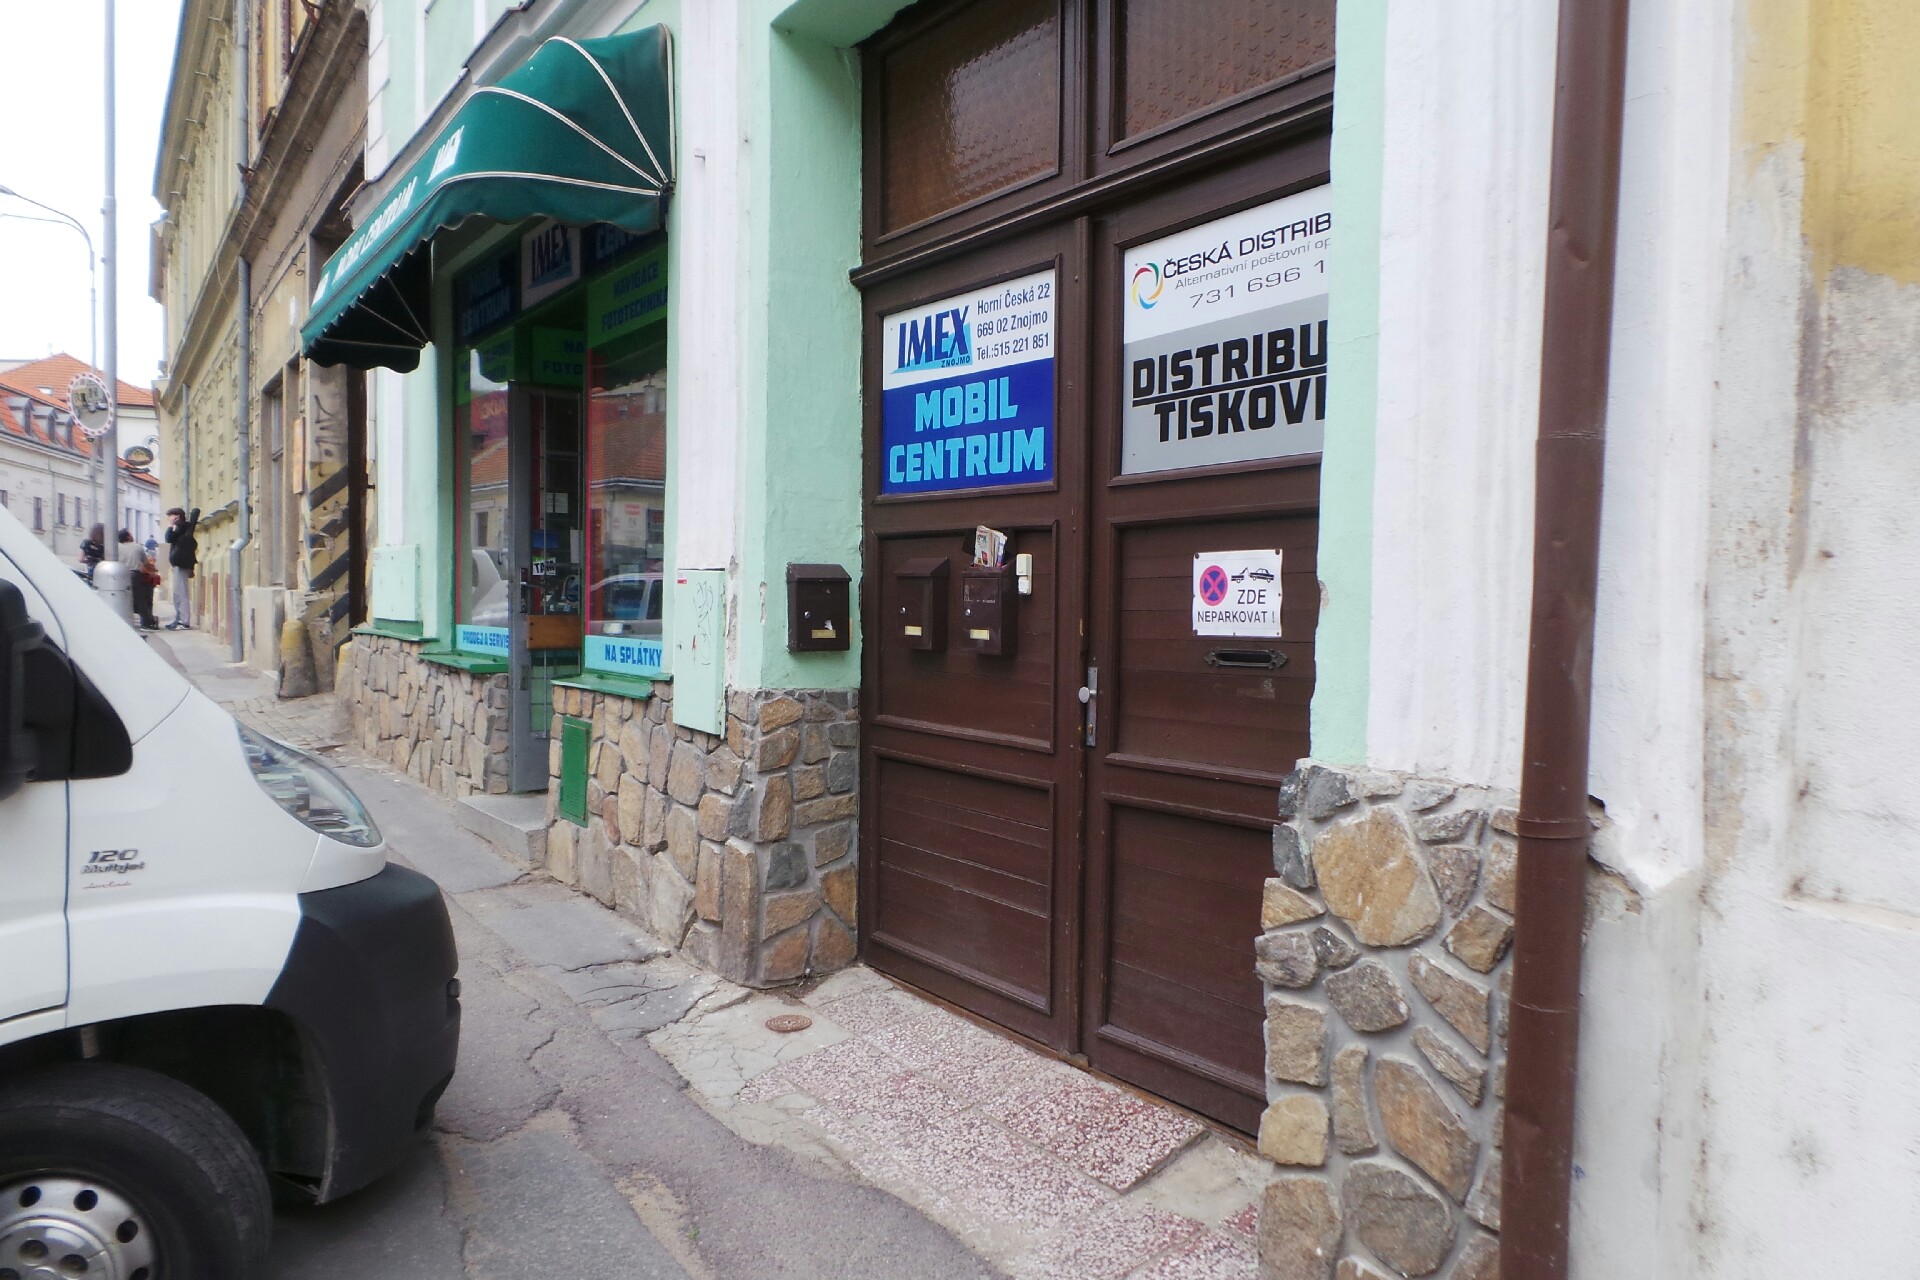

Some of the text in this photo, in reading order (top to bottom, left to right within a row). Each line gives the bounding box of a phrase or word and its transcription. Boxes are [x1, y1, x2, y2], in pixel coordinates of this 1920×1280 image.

[530, 223, 571, 282] IMEX
[1163, 212, 1332, 279] ČESKÁ DISTRIB
[613, 261, 659, 299] NAVIGACE
[1175, 260, 1248, 290] Alternativní
[1252, 242, 1311, 271] poštovní
[977, 282, 1051, 316] Horní Česká 22
[1190, 285, 1234, 308] 731
[1247, 267, 1301, 292] 696
[898, 305, 969, 369] IMEX
[977, 311, 1048, 339] 669 02 Znojmo
[1012, 337, 1029, 353] 221
[1032, 332, 1049, 348] 851
[941, 355, 971, 369] ZNOJMO
[1133, 320, 1328, 399] DISTRIBU
[915, 376, 1018, 433] MOBIL
[889, 427, 1045, 484] CENTRUM
[1237, 589, 1267, 605] ZDE
[1197, 610, 1268, 623] NEPARKOVAT
[604, 641, 662, 667] NA SPLÁTKY
[88, 849, 138, 864] 120
